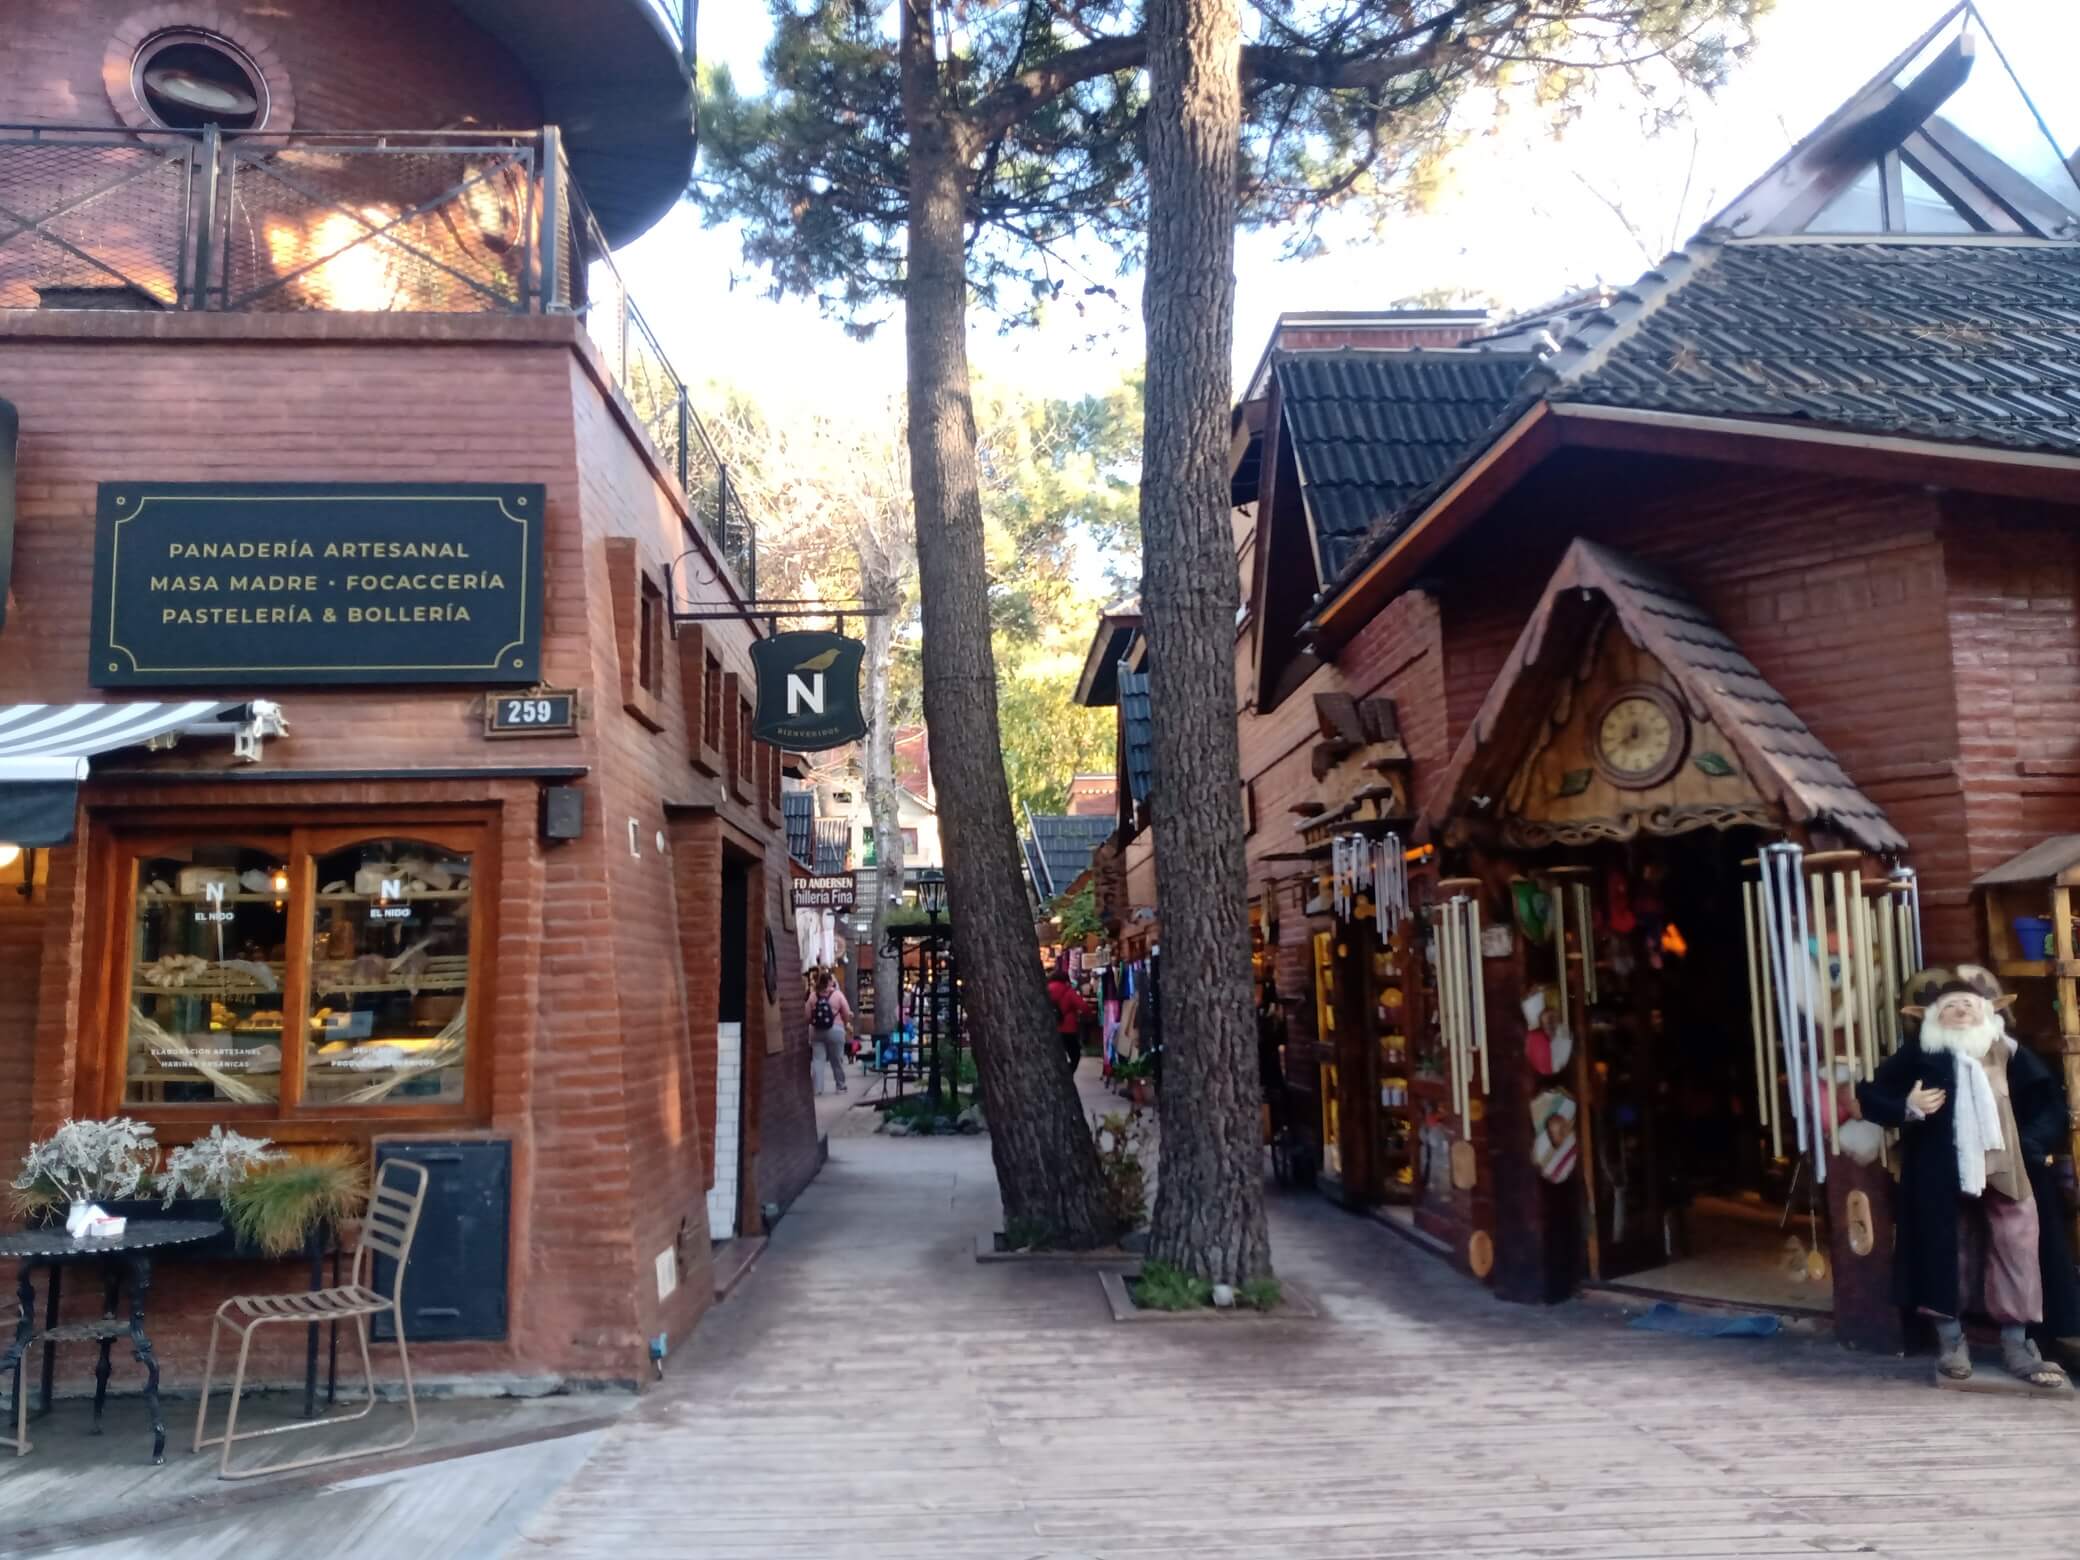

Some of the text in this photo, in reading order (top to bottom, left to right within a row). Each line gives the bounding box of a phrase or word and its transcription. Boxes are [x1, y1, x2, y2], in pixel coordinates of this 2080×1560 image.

[169, 539, 470, 559] PANADERÍA ARTESANAL
[150, 570, 505, 592] MASA MADRE FOCACCERÍA
[162, 602, 471, 625] PASTELERÍA & BOLLERÍA
[787, 672, 824, 714] N
[508, 700, 551, 723] 259
[206, 882, 224, 902] N
[381, 879, 401, 901] N
[808, 877, 854, 889] ANDERSEN
[831, 889, 854, 904] Fina
[194, 912, 235, 921] EL NIDO
[370, 907, 411, 918] EL NIDO
